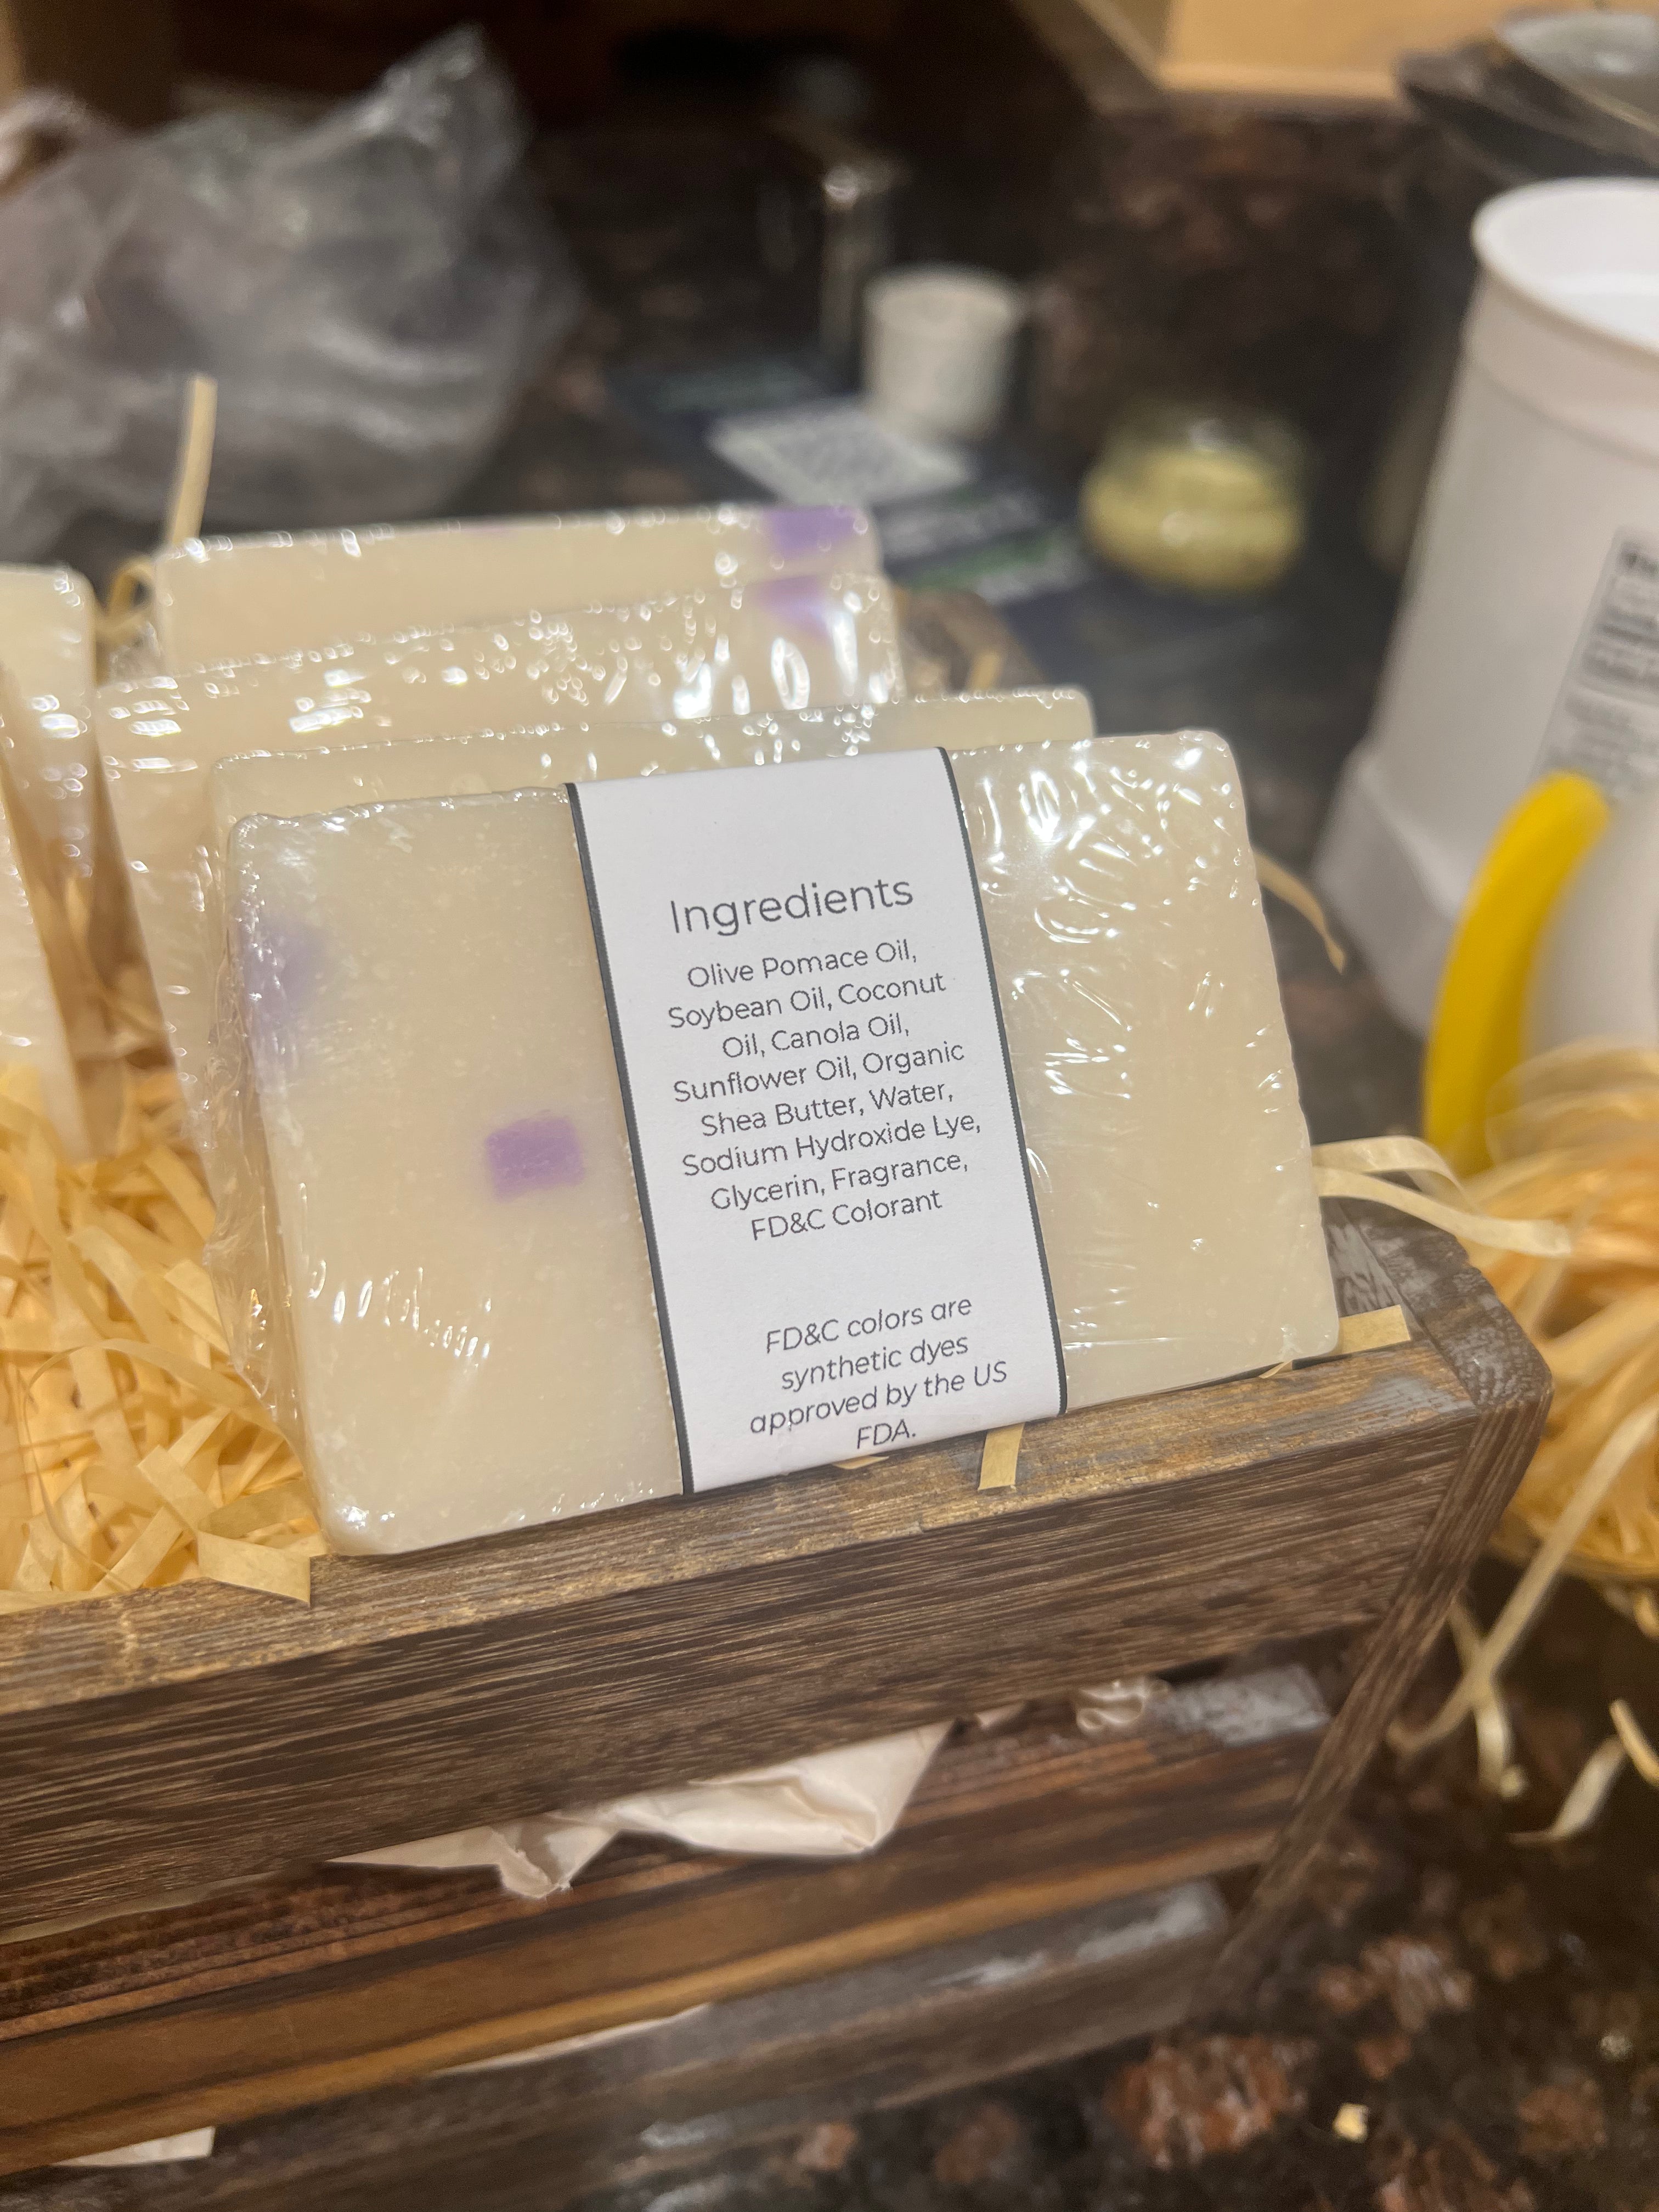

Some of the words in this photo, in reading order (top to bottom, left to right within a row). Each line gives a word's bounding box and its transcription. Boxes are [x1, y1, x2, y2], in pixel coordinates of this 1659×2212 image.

[670, 879, 913, 937] Ingredients
[687, 962, 754, 988] Olive
[761, 950, 868, 979] Pomace
[875, 938, 917, 963] Oil,
[668, 998, 782, 1030] Soybean
[790, 986, 832, 1012] Oil,
[838, 972, 947, 1005] Coconut
[722, 1032, 765, 1058] Oil,
[771, 1020, 860, 1051] Canola
[867, 1012, 909, 1037] Oil,
[673, 1067, 807, 1103] Sunflower
[816, 1055, 857, 1081] Oil,
[862, 1040, 965, 1075] Organic
[701, 1111, 767, 1137] Shea
[775, 1097, 864, 1126] Butter,
[868, 1083, 953, 1110] Water,
[682, 1145, 788, 1176] Sodium
[795, 1119, 926, 1161] Hydroxide
[932, 1115, 981, 1139] Lye,
[710, 1174, 825, 1211] Glycerin,
[831, 1154, 968, 1190] Fragrance,
[751, 1208, 826, 1241] FD&C
[832, 1189, 943, 1226] Colorant
[766, 1318, 839, 1354] FD&C
[847, 1307, 923, 1338] colors
[930, 1299, 972, 1321] are
[781, 1346, 902, 1393] synthetic
[910, 1336, 969, 1366] dyes
[750, 1385, 878, 1436] approved
[886, 1383, 918, 1408] by
[923, 1373, 965, 1397] the
[974, 1361, 1007, 1387] US
[856, 1418, 916, 1450] FDA.
